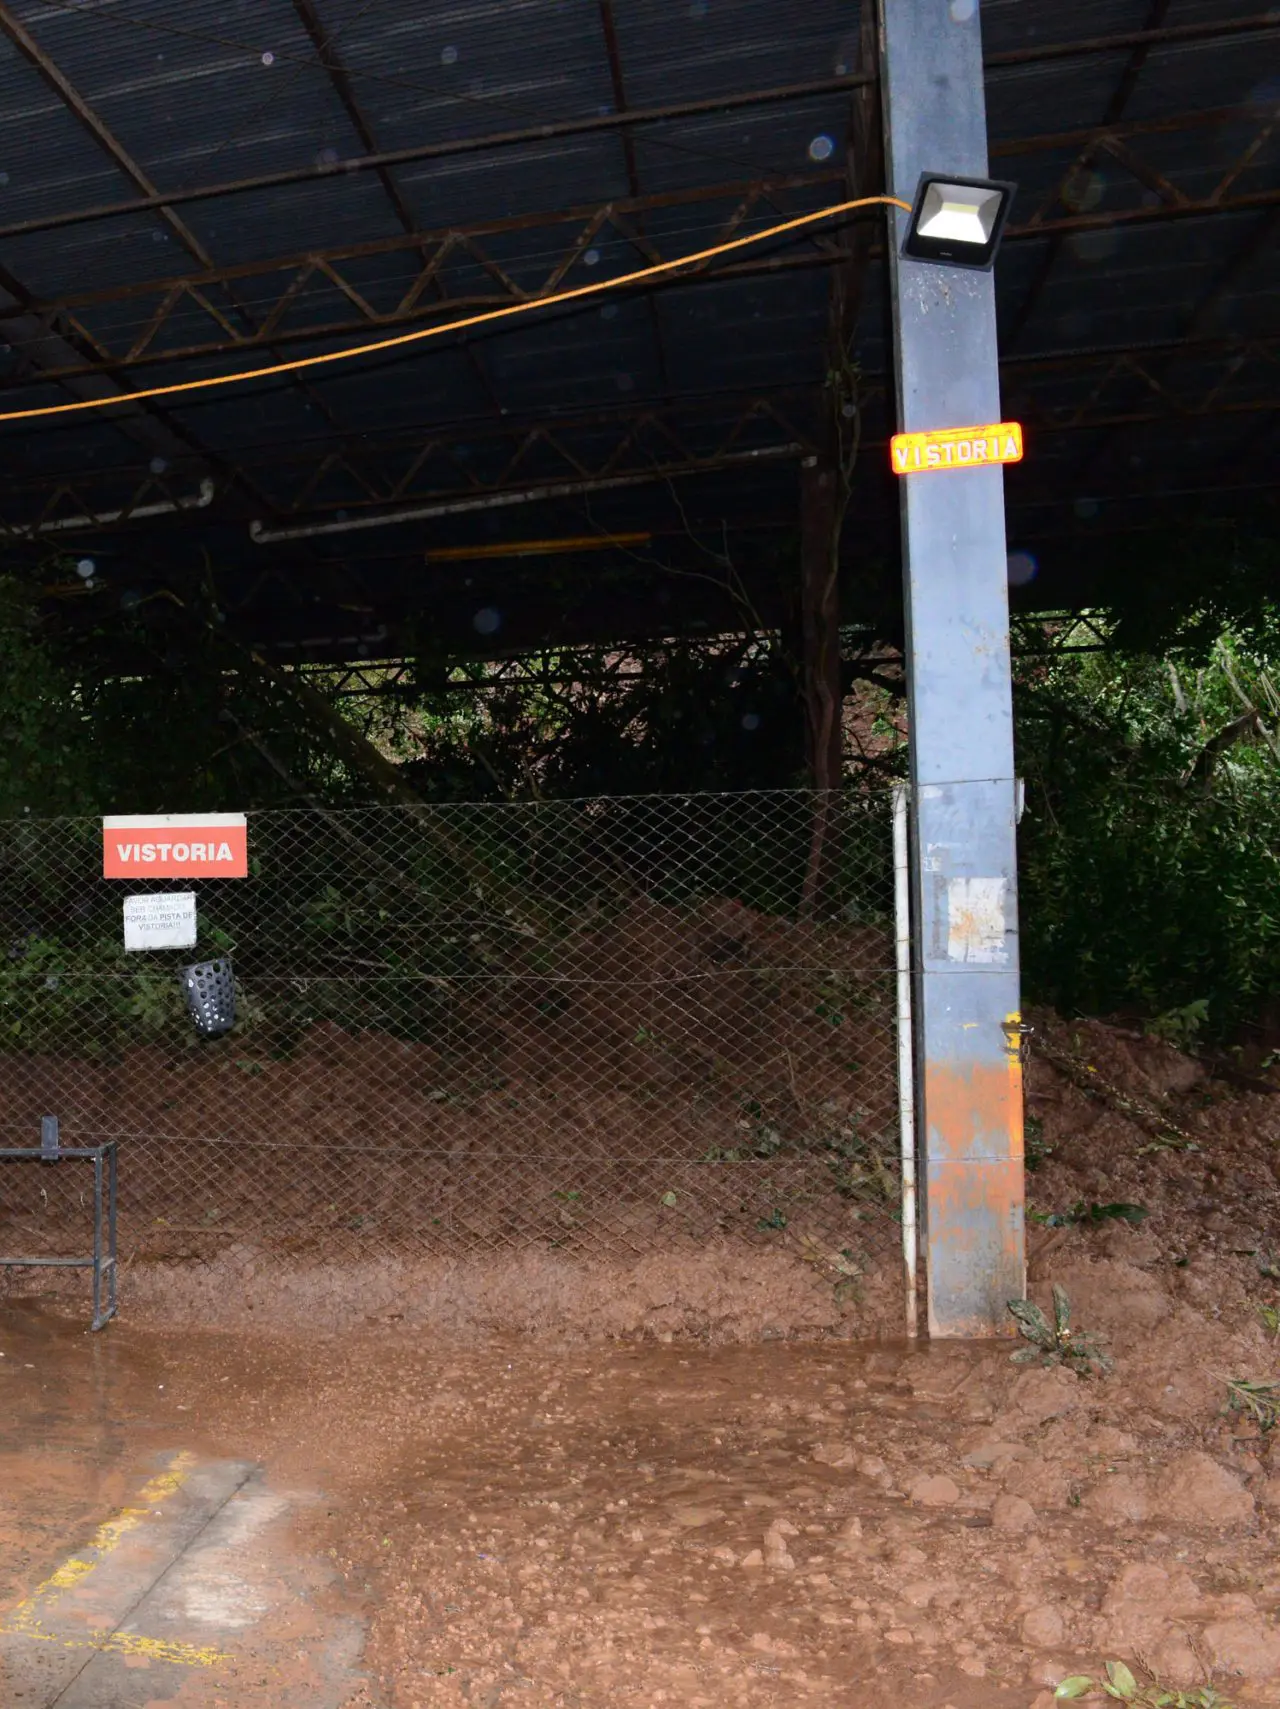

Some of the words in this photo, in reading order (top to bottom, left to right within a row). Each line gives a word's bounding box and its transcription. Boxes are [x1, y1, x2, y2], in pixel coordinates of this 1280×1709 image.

[896, 436, 1019, 469] VISTORIA
[116, 843, 234, 862] VISTORIA
[160, 912, 181, 921] PISTA
